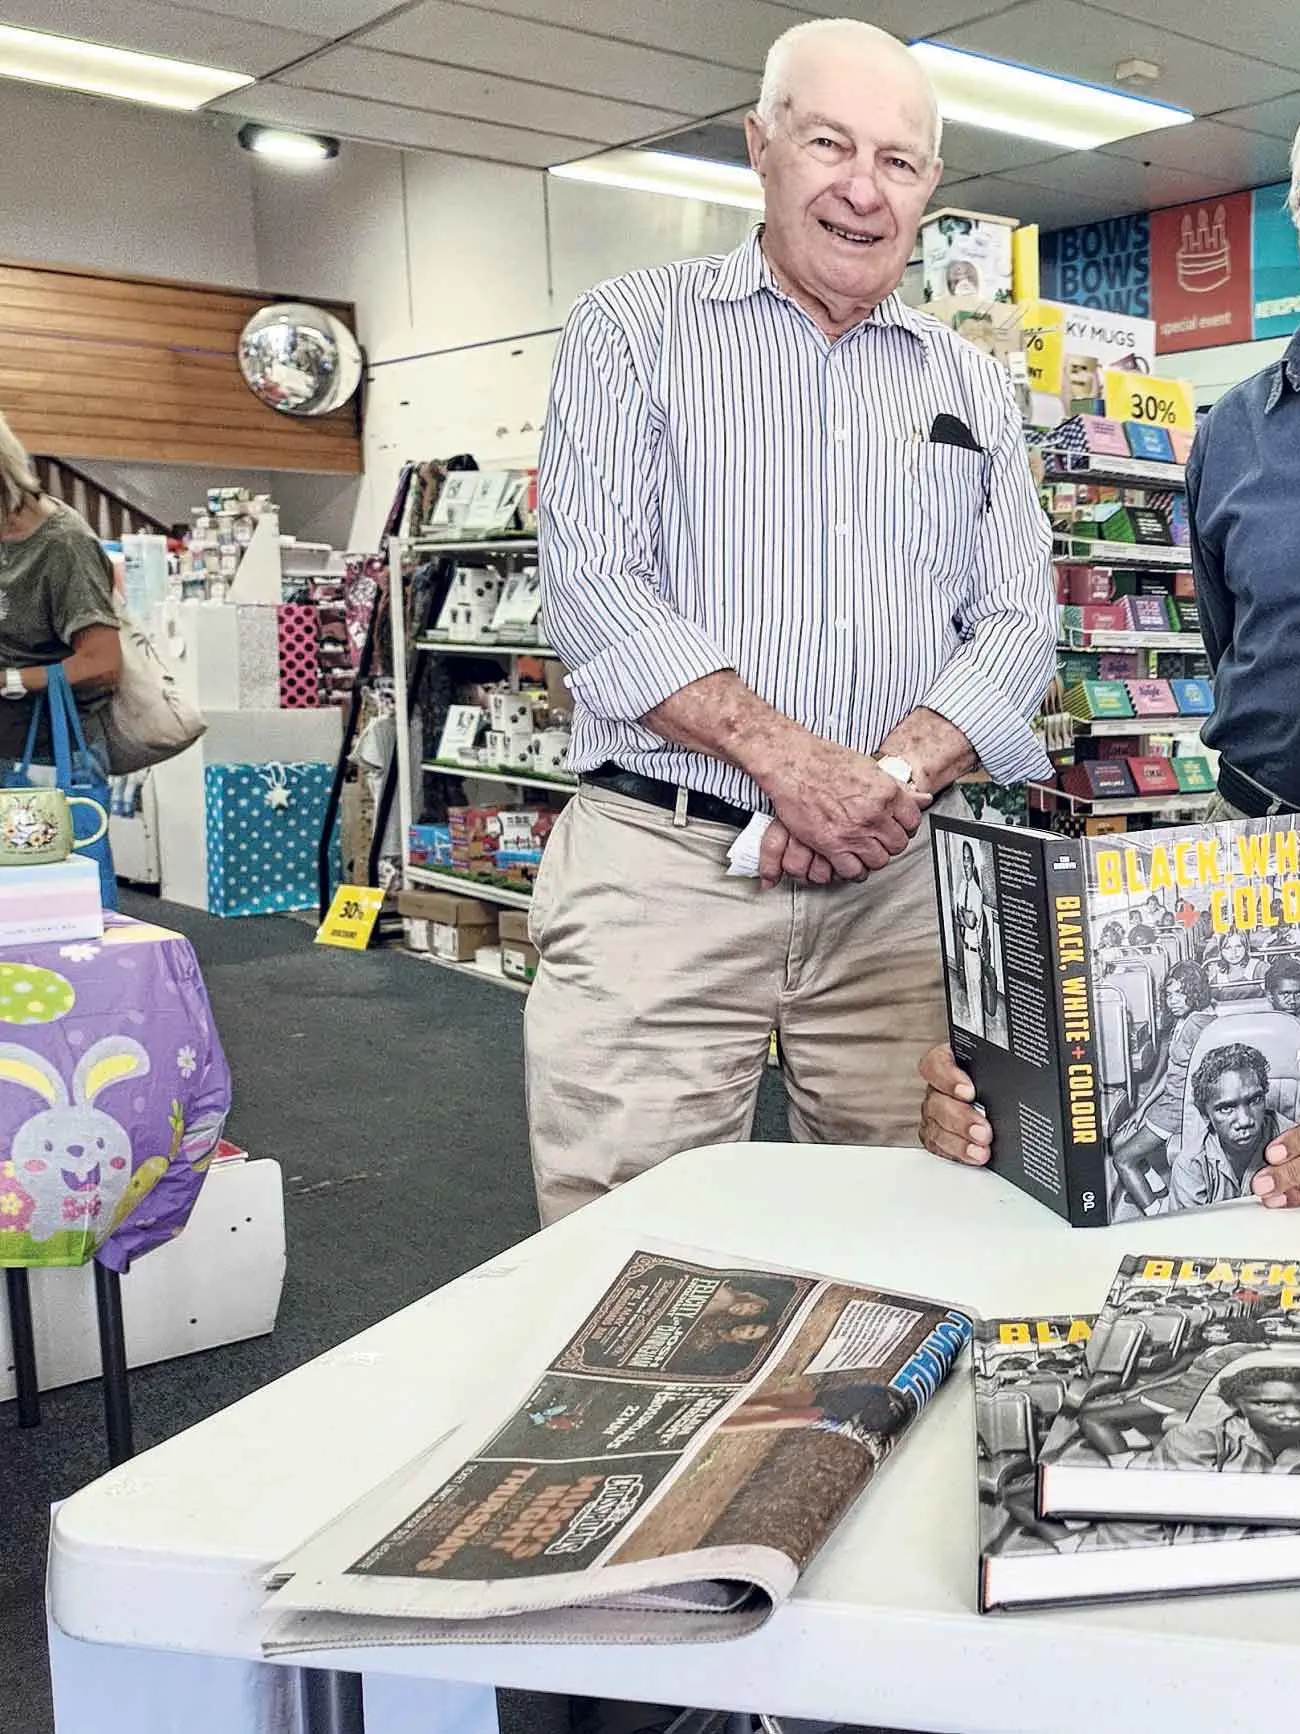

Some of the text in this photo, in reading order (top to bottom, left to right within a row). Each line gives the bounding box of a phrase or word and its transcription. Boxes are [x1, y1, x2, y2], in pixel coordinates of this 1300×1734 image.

[1060, 252, 1149, 298] BOWS
[1093, 325, 1136, 347] MUGS
[1131, 394, 1177, 424] 30%
[1055, 895, 1088, 973] BLACK,
[1061, 976, 1092, 1044] WHITE
[1066, 1063, 1097, 1145] COLOUR
